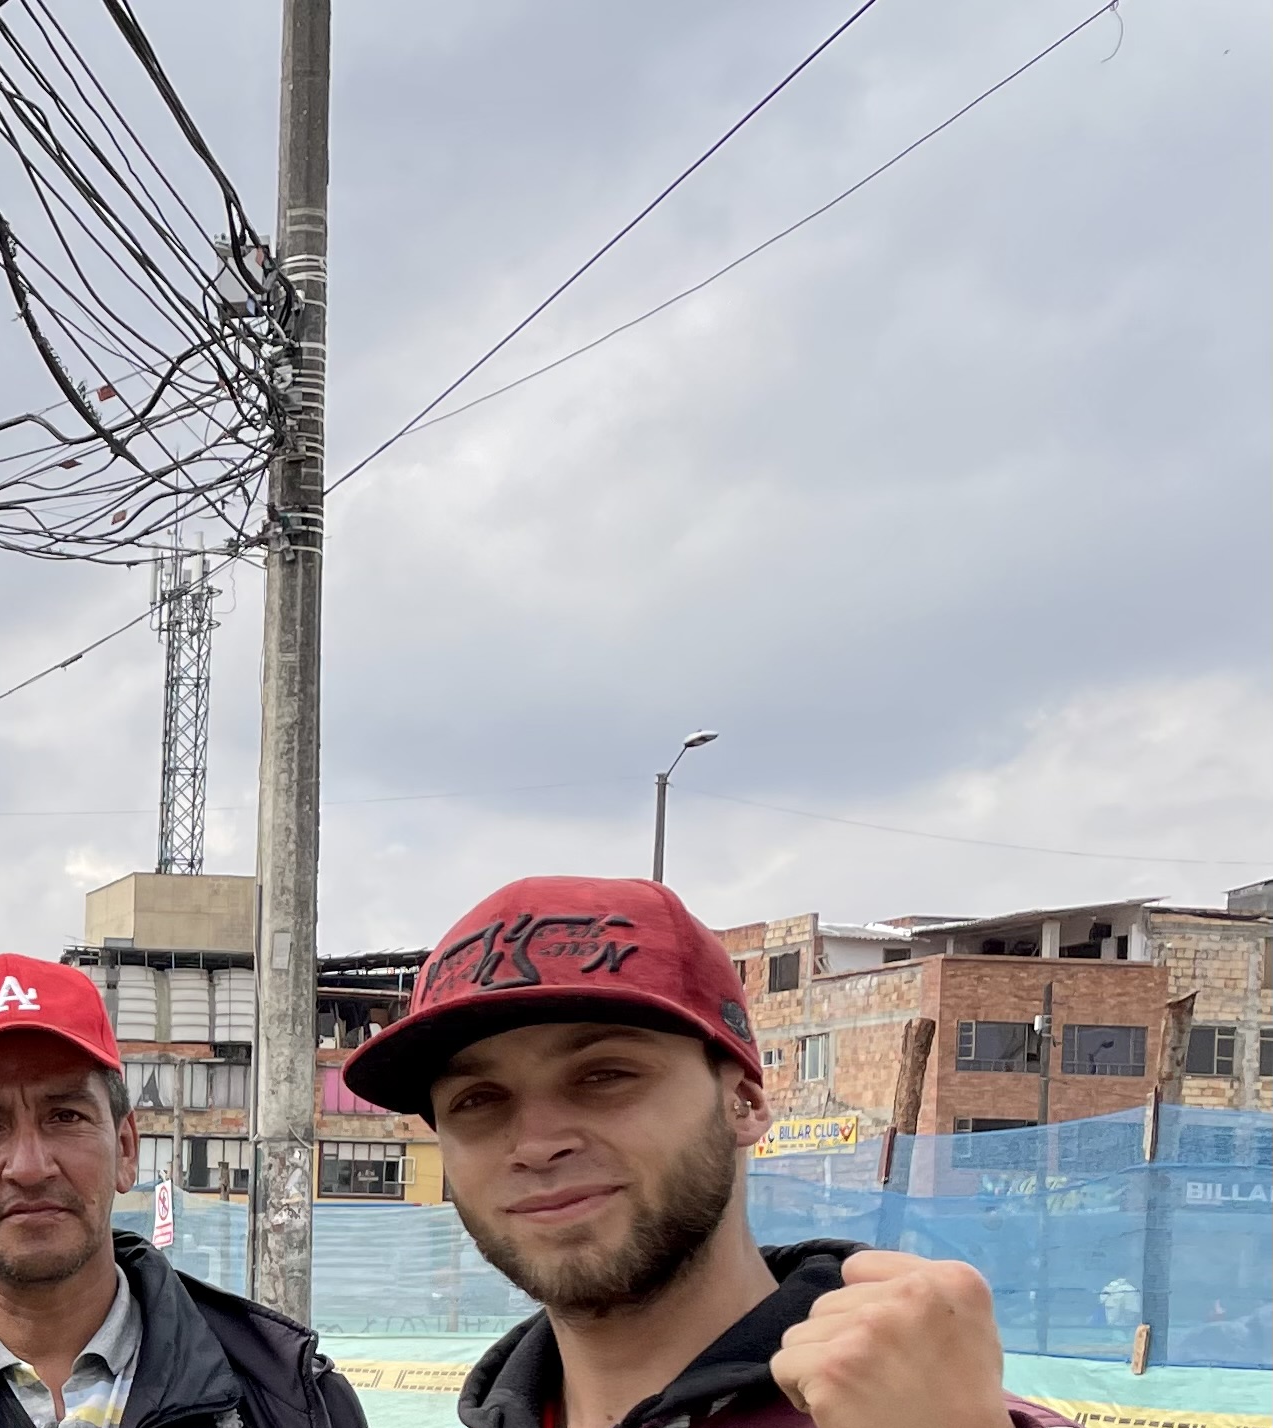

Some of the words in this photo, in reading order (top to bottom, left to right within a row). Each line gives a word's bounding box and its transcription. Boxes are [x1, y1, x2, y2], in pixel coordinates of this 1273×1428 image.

[779, 1124, 811, 1140] BILLAR
[814, 1123, 840, 1138] CLUB
[1186, 1182, 1273, 1202] BILLA
